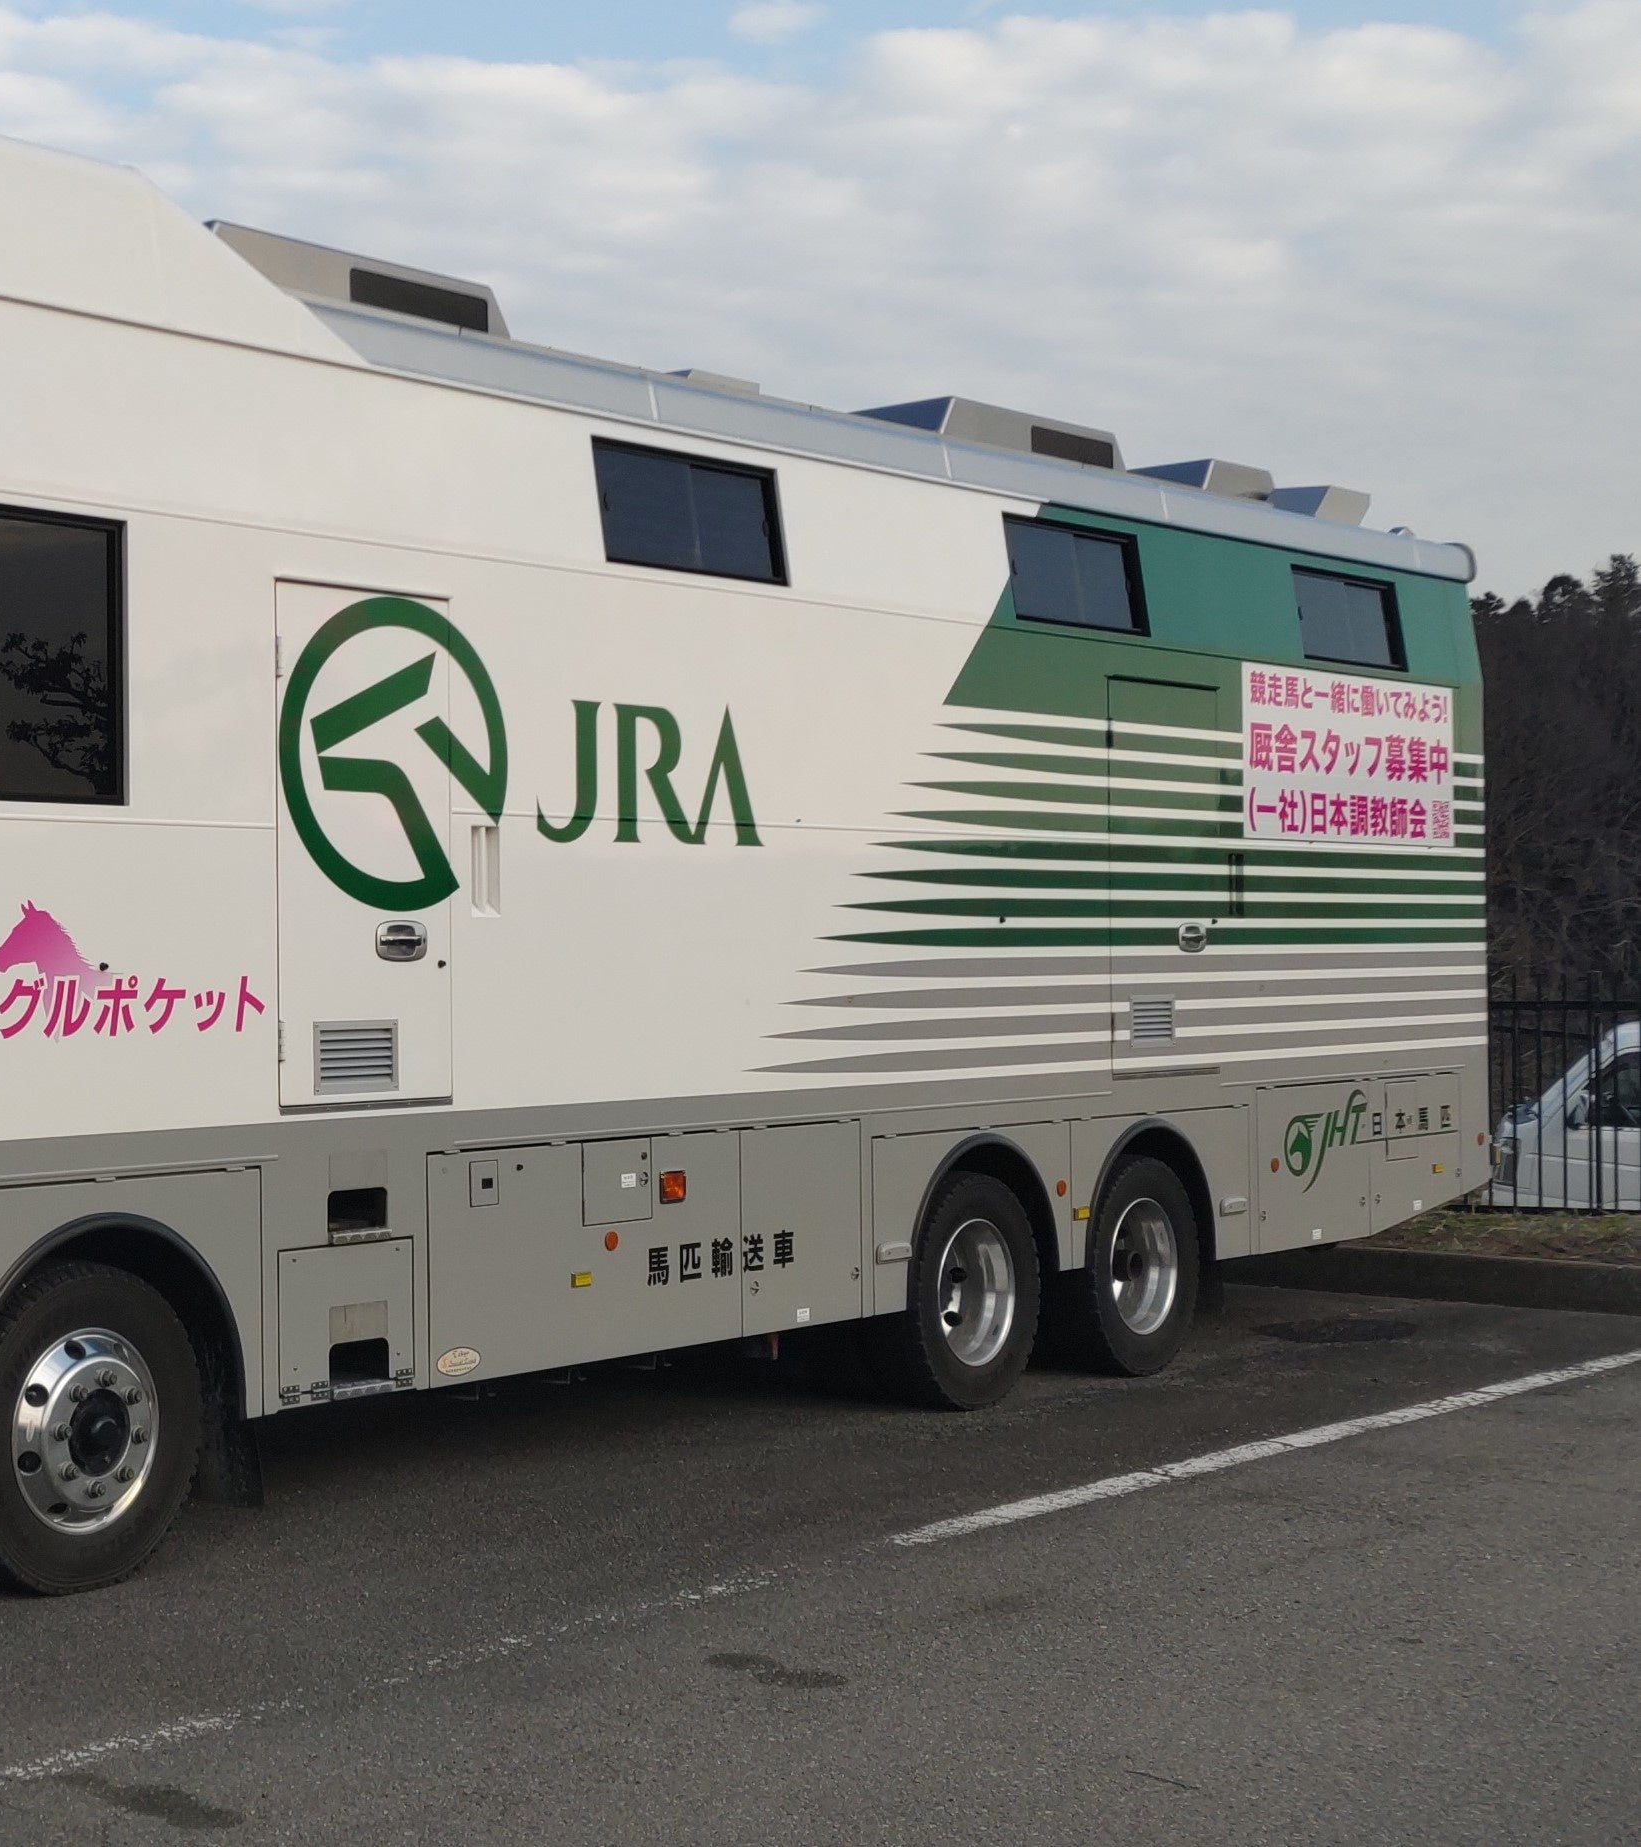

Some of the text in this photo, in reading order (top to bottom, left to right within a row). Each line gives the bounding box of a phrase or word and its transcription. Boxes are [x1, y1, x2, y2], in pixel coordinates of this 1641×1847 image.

[536, 699, 766, 847] JRA
[1248, 721, 1449, 785] 厩舎スタッフ募集中
[646, 1229, 795, 1287] 馬匹輸送車
